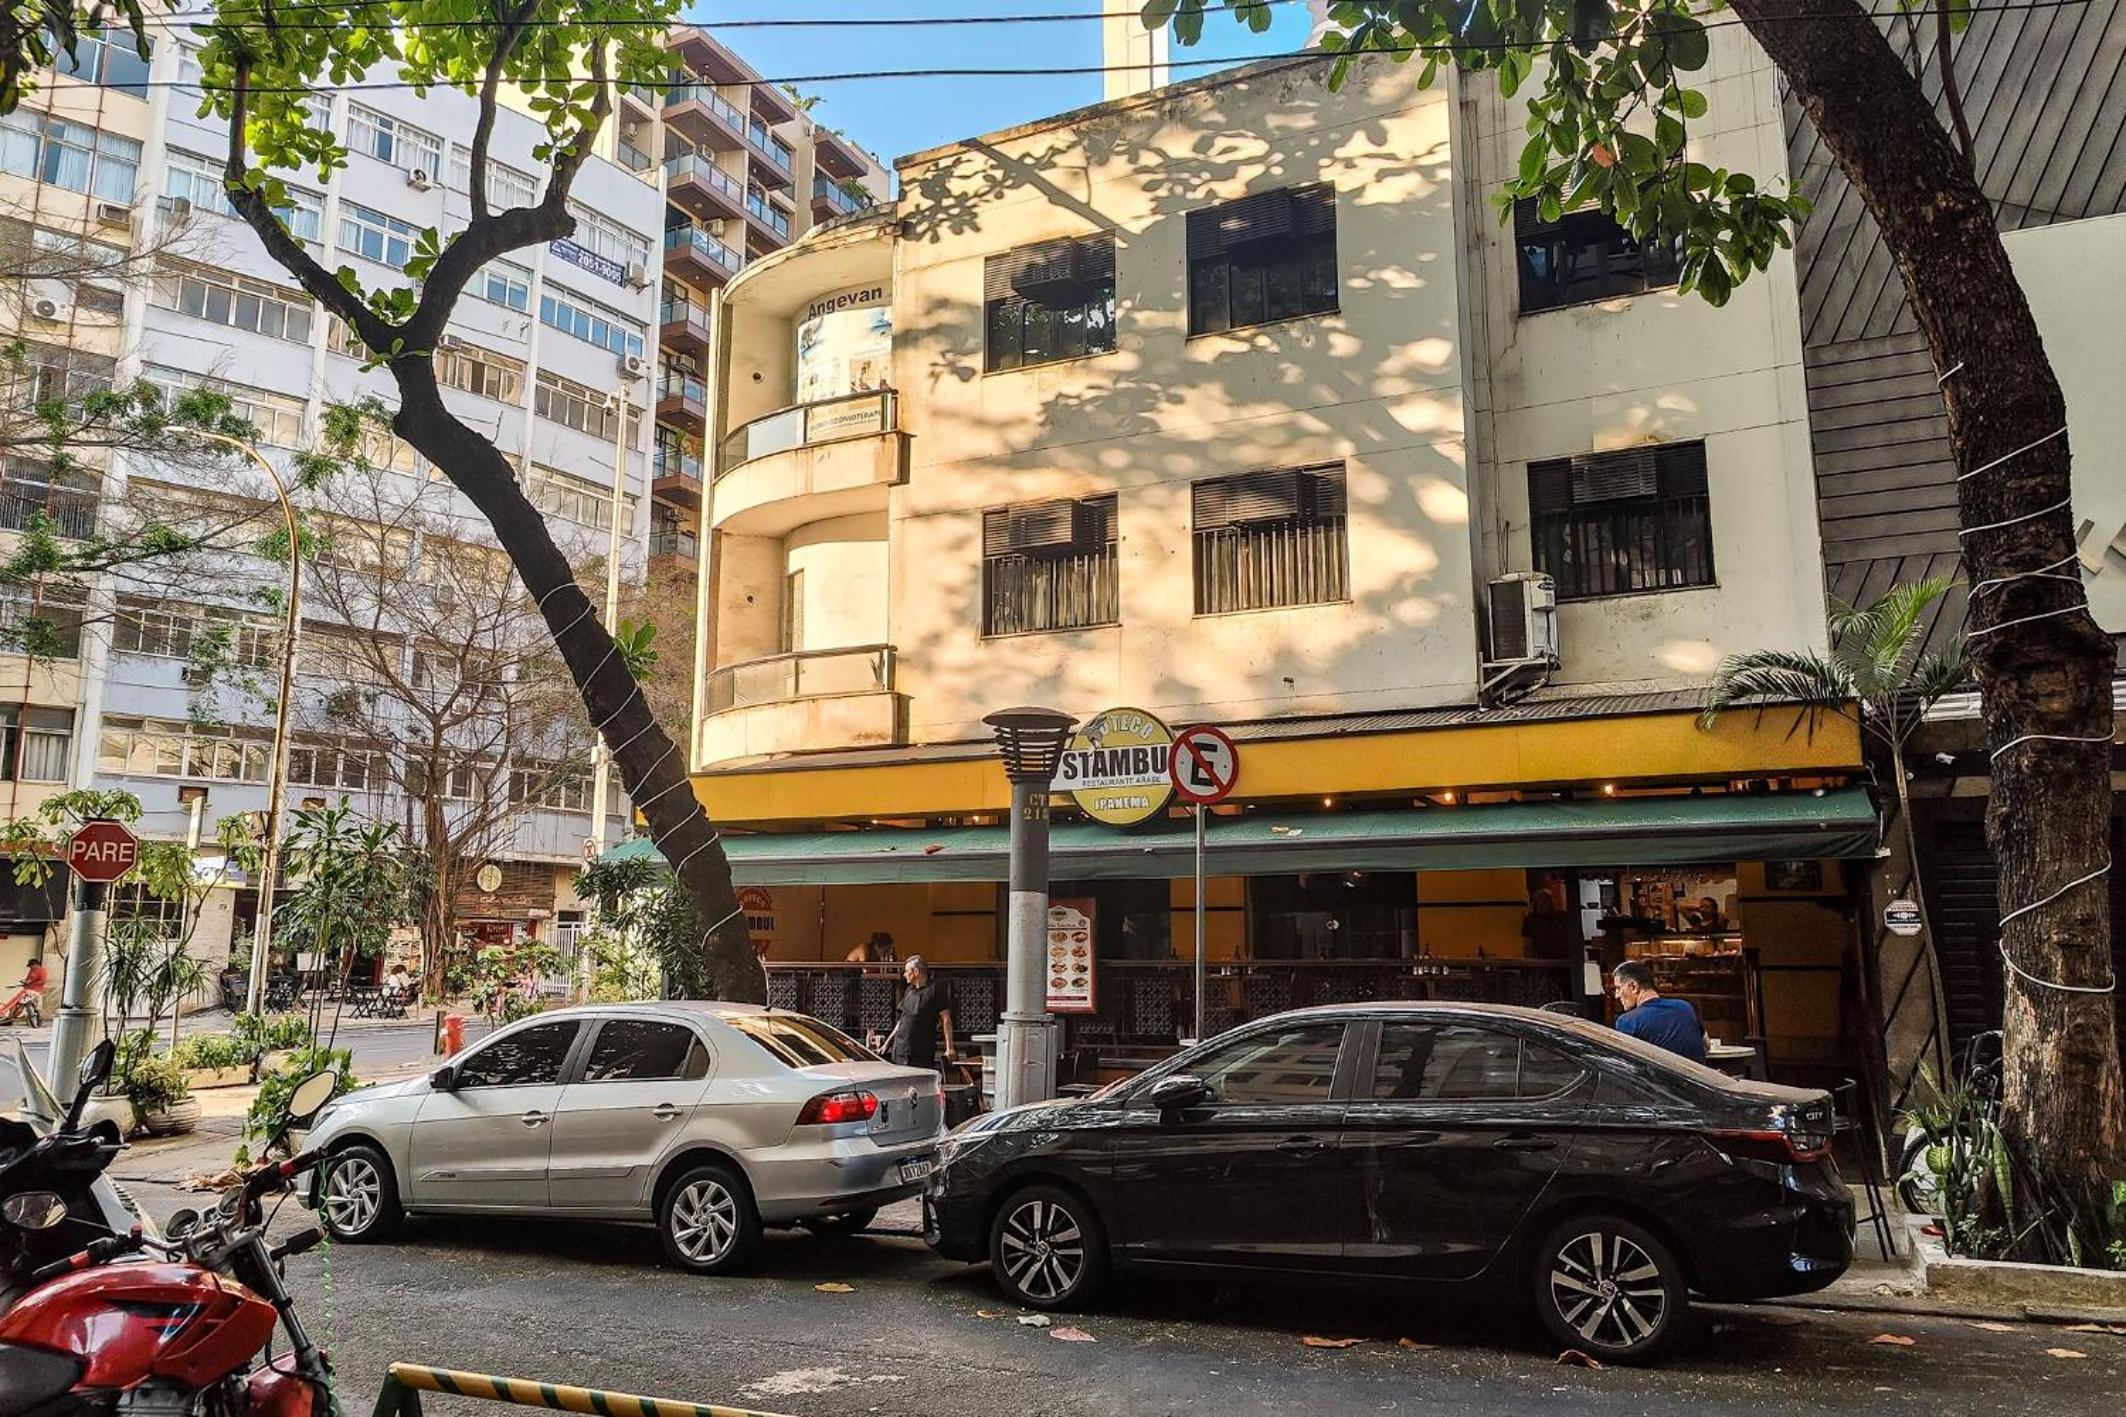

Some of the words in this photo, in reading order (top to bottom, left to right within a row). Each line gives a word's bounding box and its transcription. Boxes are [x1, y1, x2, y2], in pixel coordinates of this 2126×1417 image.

[807, 286, 883, 322] Angevan
[1062, 746, 1168, 780] STAMBU
[1093, 796, 1150, 810] IPANEMA
[70, 840, 135, 863] PARE
[1806, 1111, 1823, 1121] CITY
